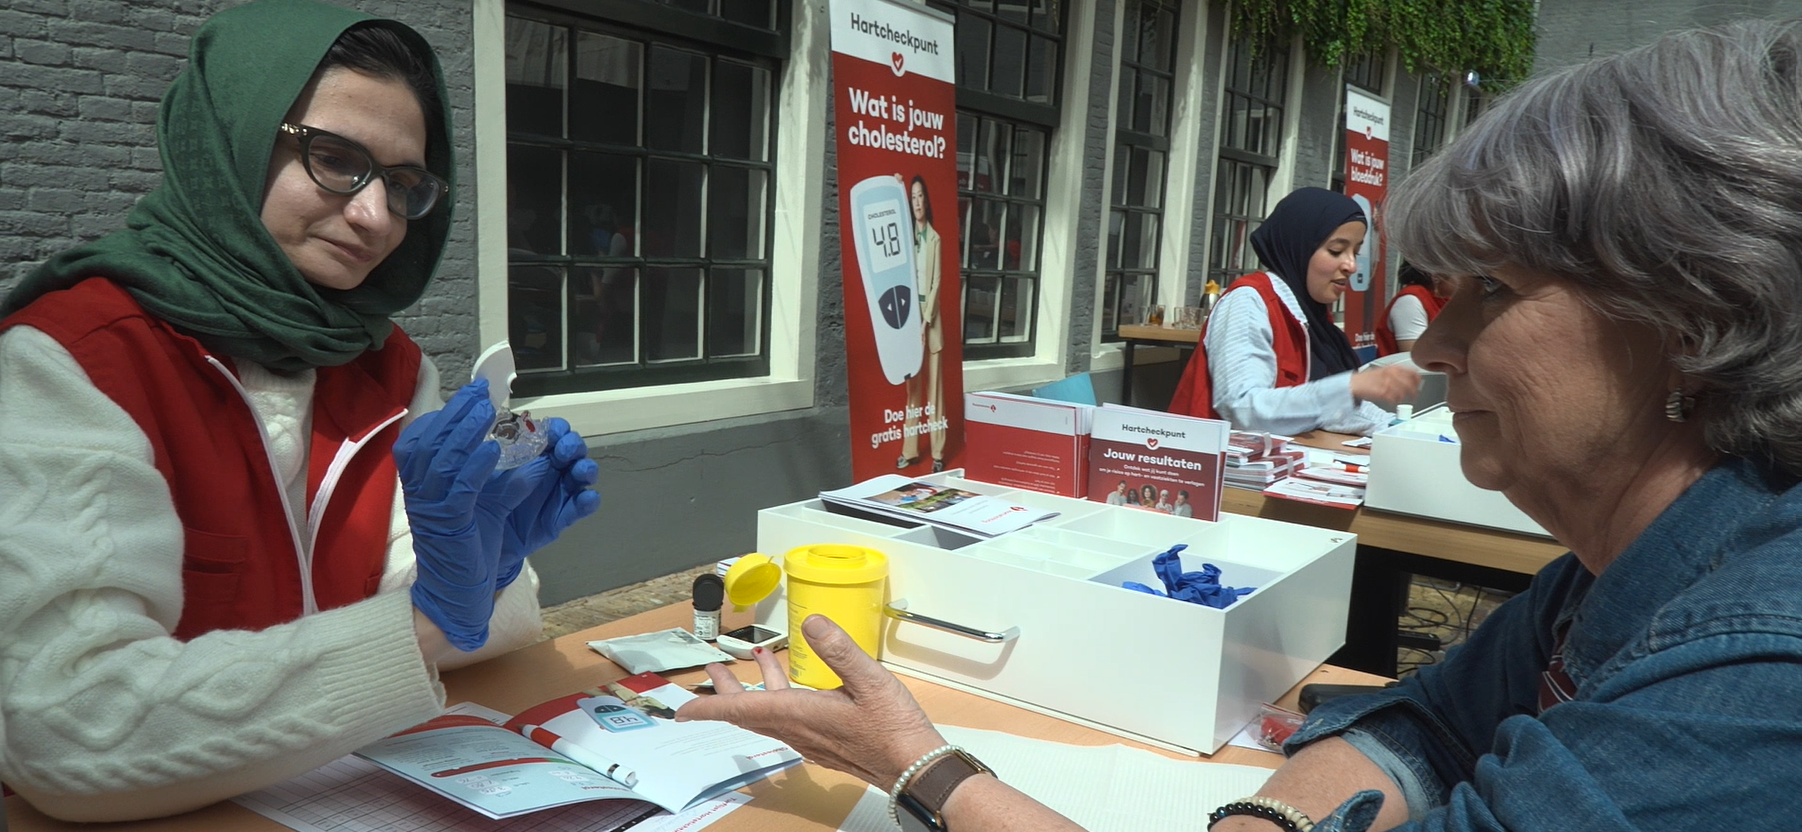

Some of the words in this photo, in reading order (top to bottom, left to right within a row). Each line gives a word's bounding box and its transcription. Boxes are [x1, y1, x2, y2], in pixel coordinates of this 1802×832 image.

[851, 12, 939, 55] Hartcheckpunt
[848, 87, 888, 120] Wat
[892, 95, 905, 122] is
[908, 99, 944, 132] jouw
[848, 120, 946, 159] cholesterol?
[1350, 148, 1365, 166] Wat
[1365, 151, 1371, 167] is
[1370, 152, 1384, 174] jouw
[1351, 166, 1383, 187] bloeddruk?
[868, 209, 897, 220] CHOLESTEROL
[872, 222, 901, 258] 4.8
[884, 409, 904, 423] Doe
[906, 404, 923, 419] hier
[924, 402, 936, 416] de
[871, 425, 902, 449] gratis
[903, 416, 949, 438] hartcheck
[1122, 424, 1186, 439] Hartcheckpunt
[1103, 448, 1136, 461] Jouw
[1138, 452, 1202, 471] resultaten
